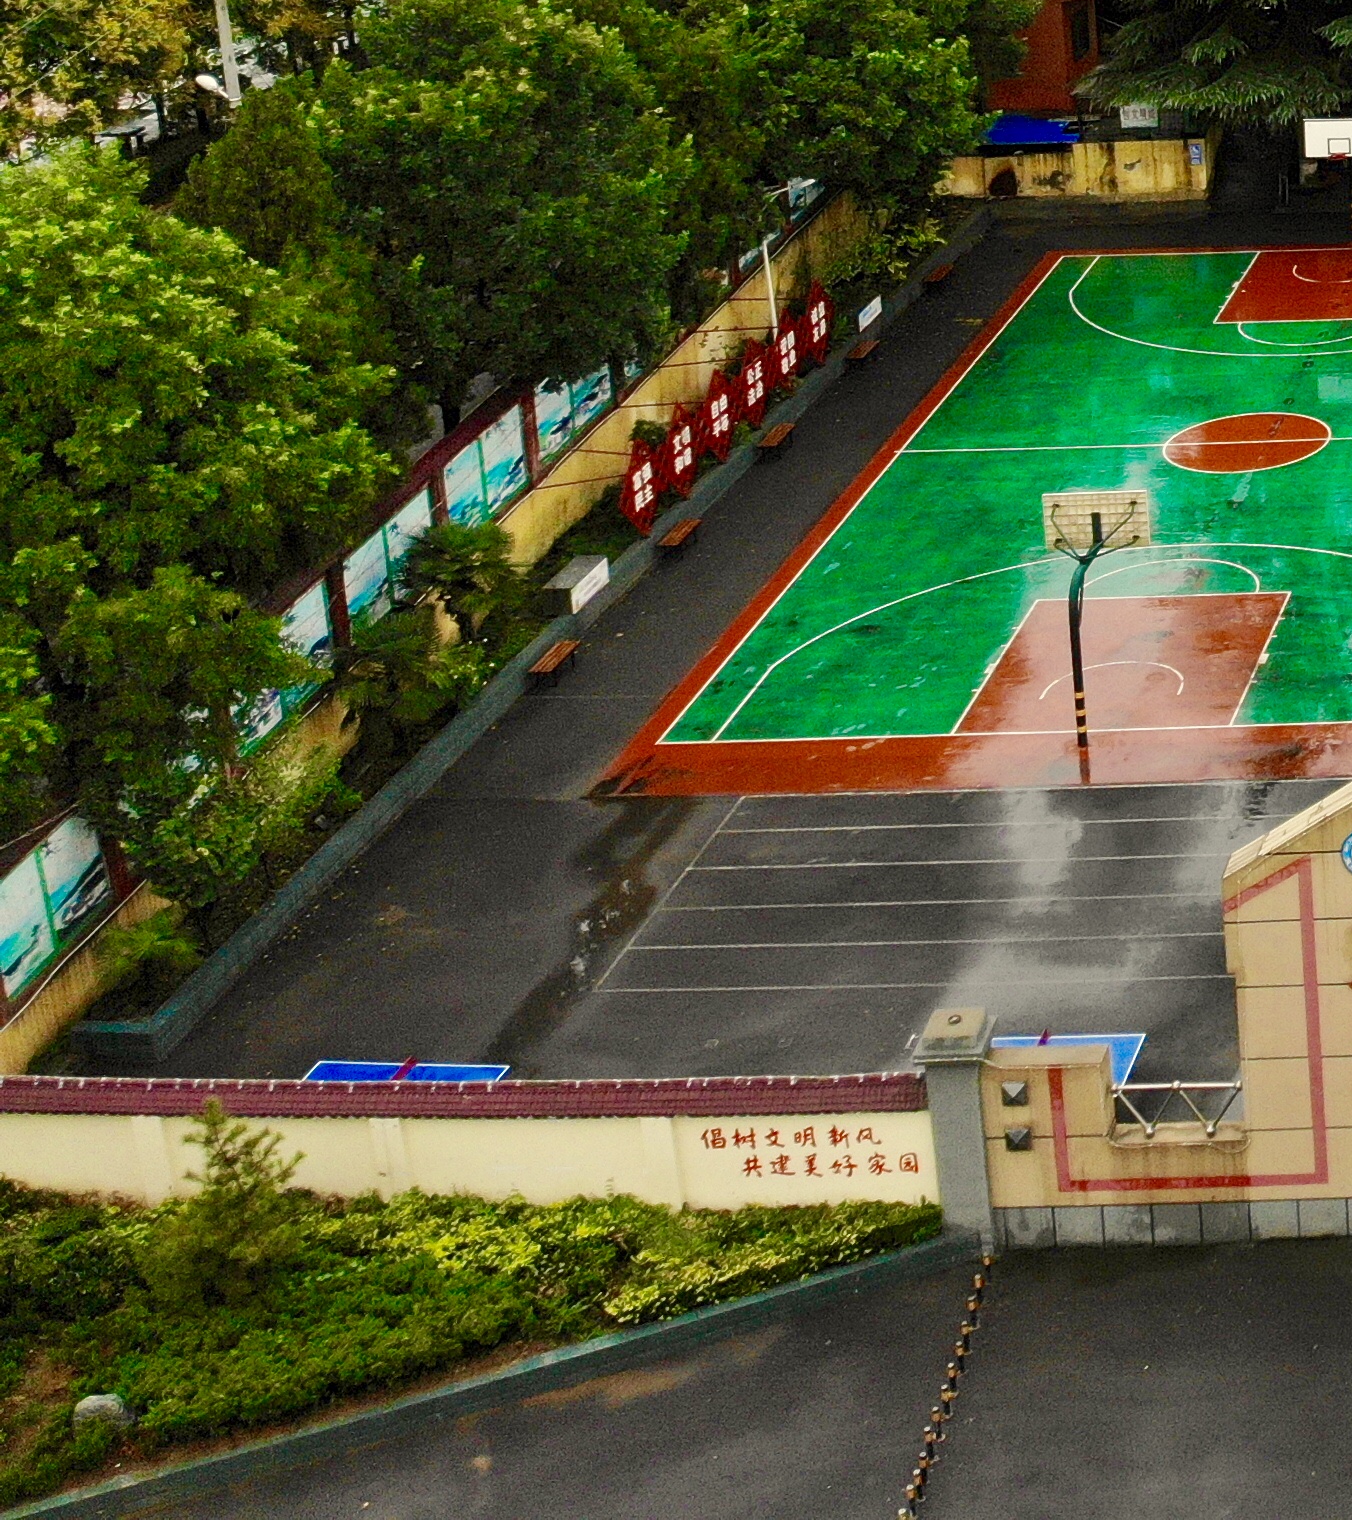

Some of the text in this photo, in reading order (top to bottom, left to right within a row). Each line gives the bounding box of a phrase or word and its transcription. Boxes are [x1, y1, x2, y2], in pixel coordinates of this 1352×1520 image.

[700, 1125, 883, 1151] 倡树文明新风
[742, 1151, 920, 1179] 共建美好家园
